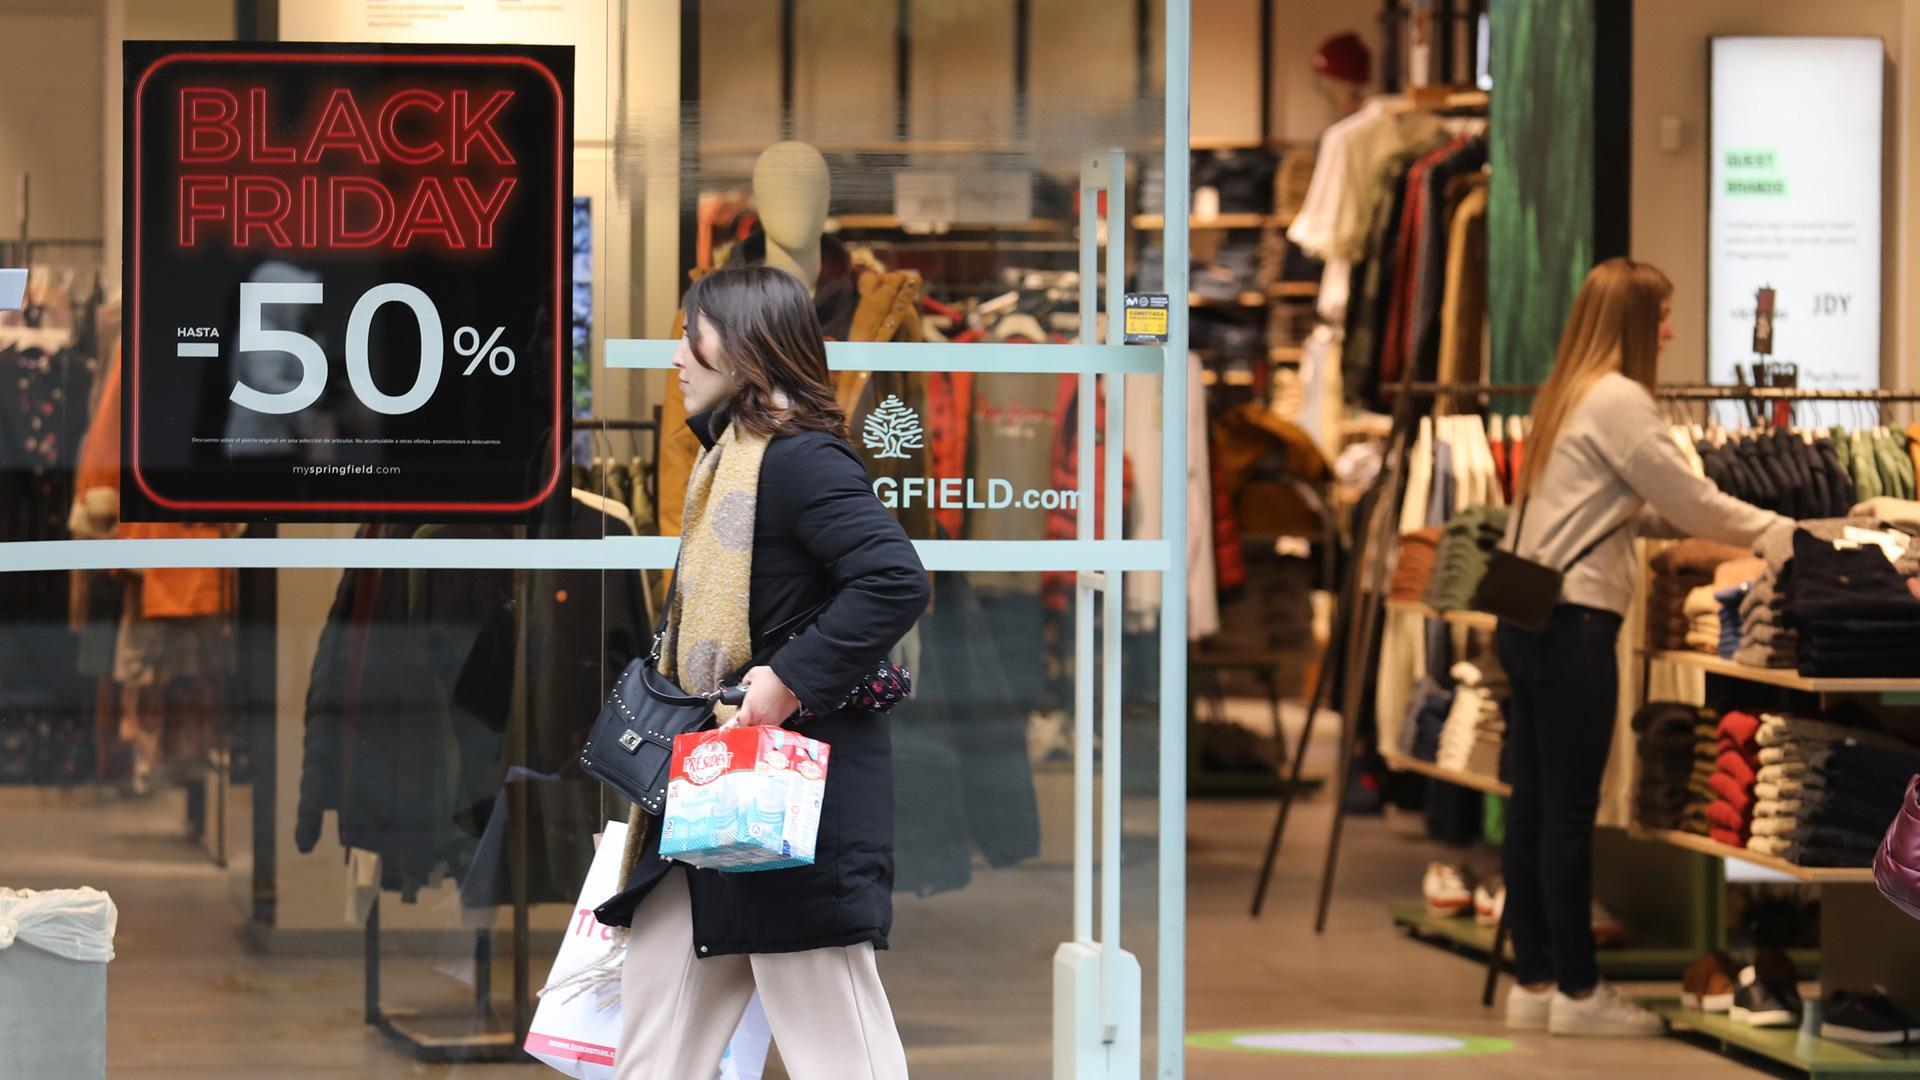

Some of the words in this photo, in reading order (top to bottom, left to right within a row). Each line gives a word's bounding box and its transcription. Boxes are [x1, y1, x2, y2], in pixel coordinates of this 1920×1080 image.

[179, 88, 516, 165] BLACK
[179, 175, 518, 249] FRIDAY
[177, 327, 220, 338] HASTA
[292, 463, 401, 476] myspringfield.com
[872, 476, 1084, 510] GFIELD.com
